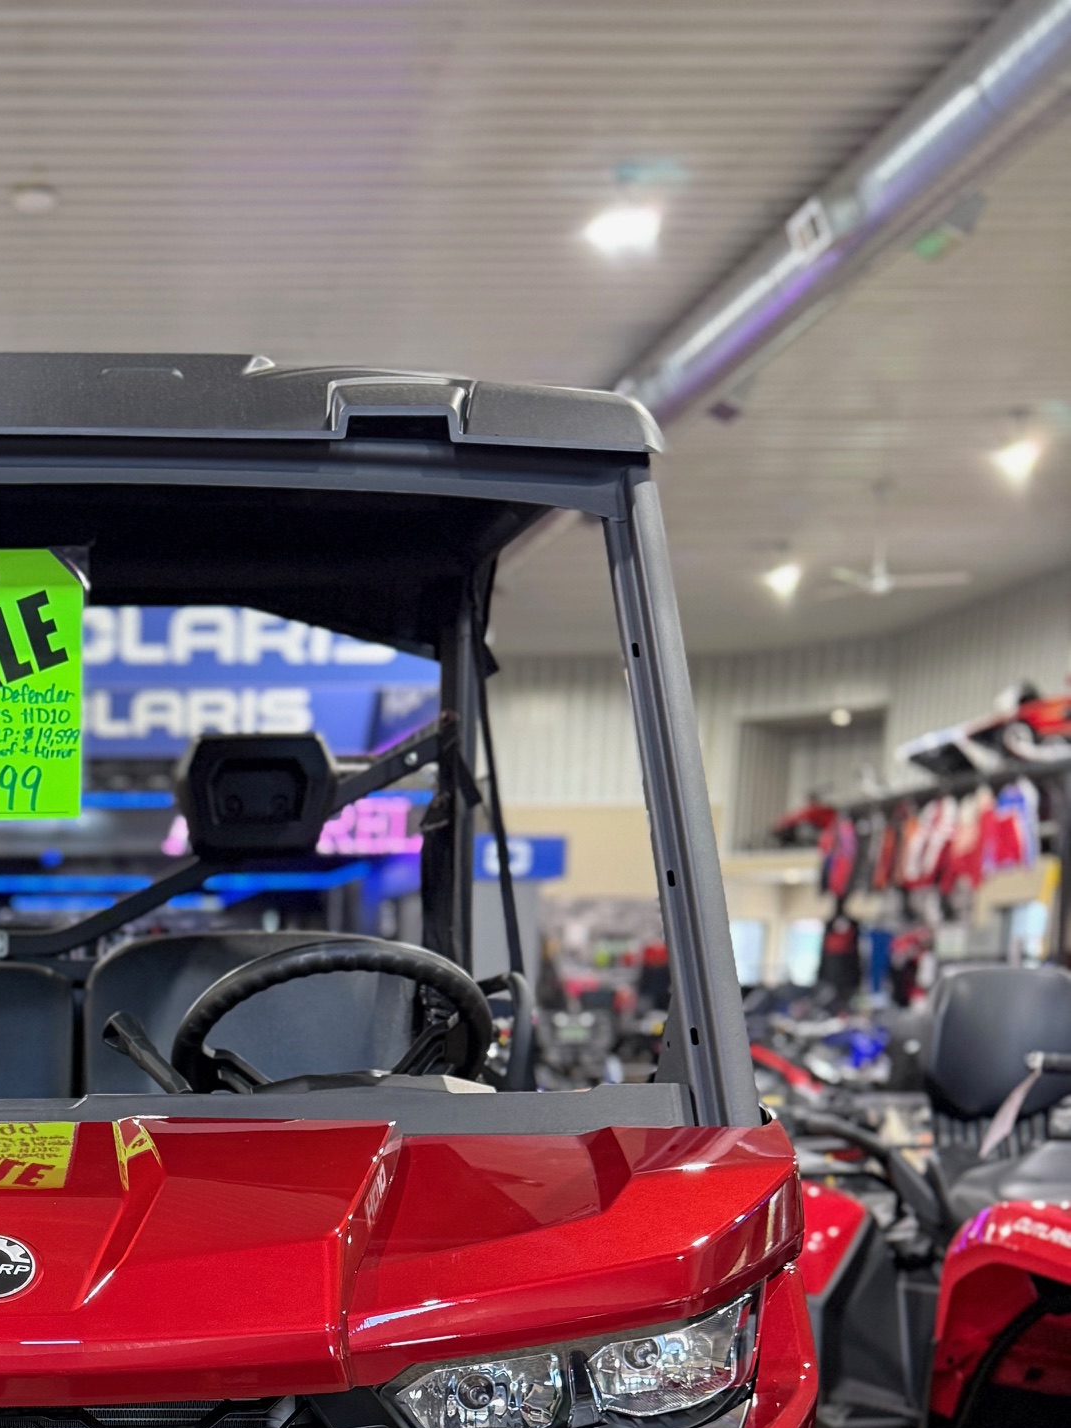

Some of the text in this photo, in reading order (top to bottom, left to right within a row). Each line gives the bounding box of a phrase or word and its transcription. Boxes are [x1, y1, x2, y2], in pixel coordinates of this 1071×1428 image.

[82, 606, 397, 665] OLARI
[1, 683, 76, 704] Defender
[21, 707, 71, 724] HD10
[82, 687, 313, 738] LARIS
